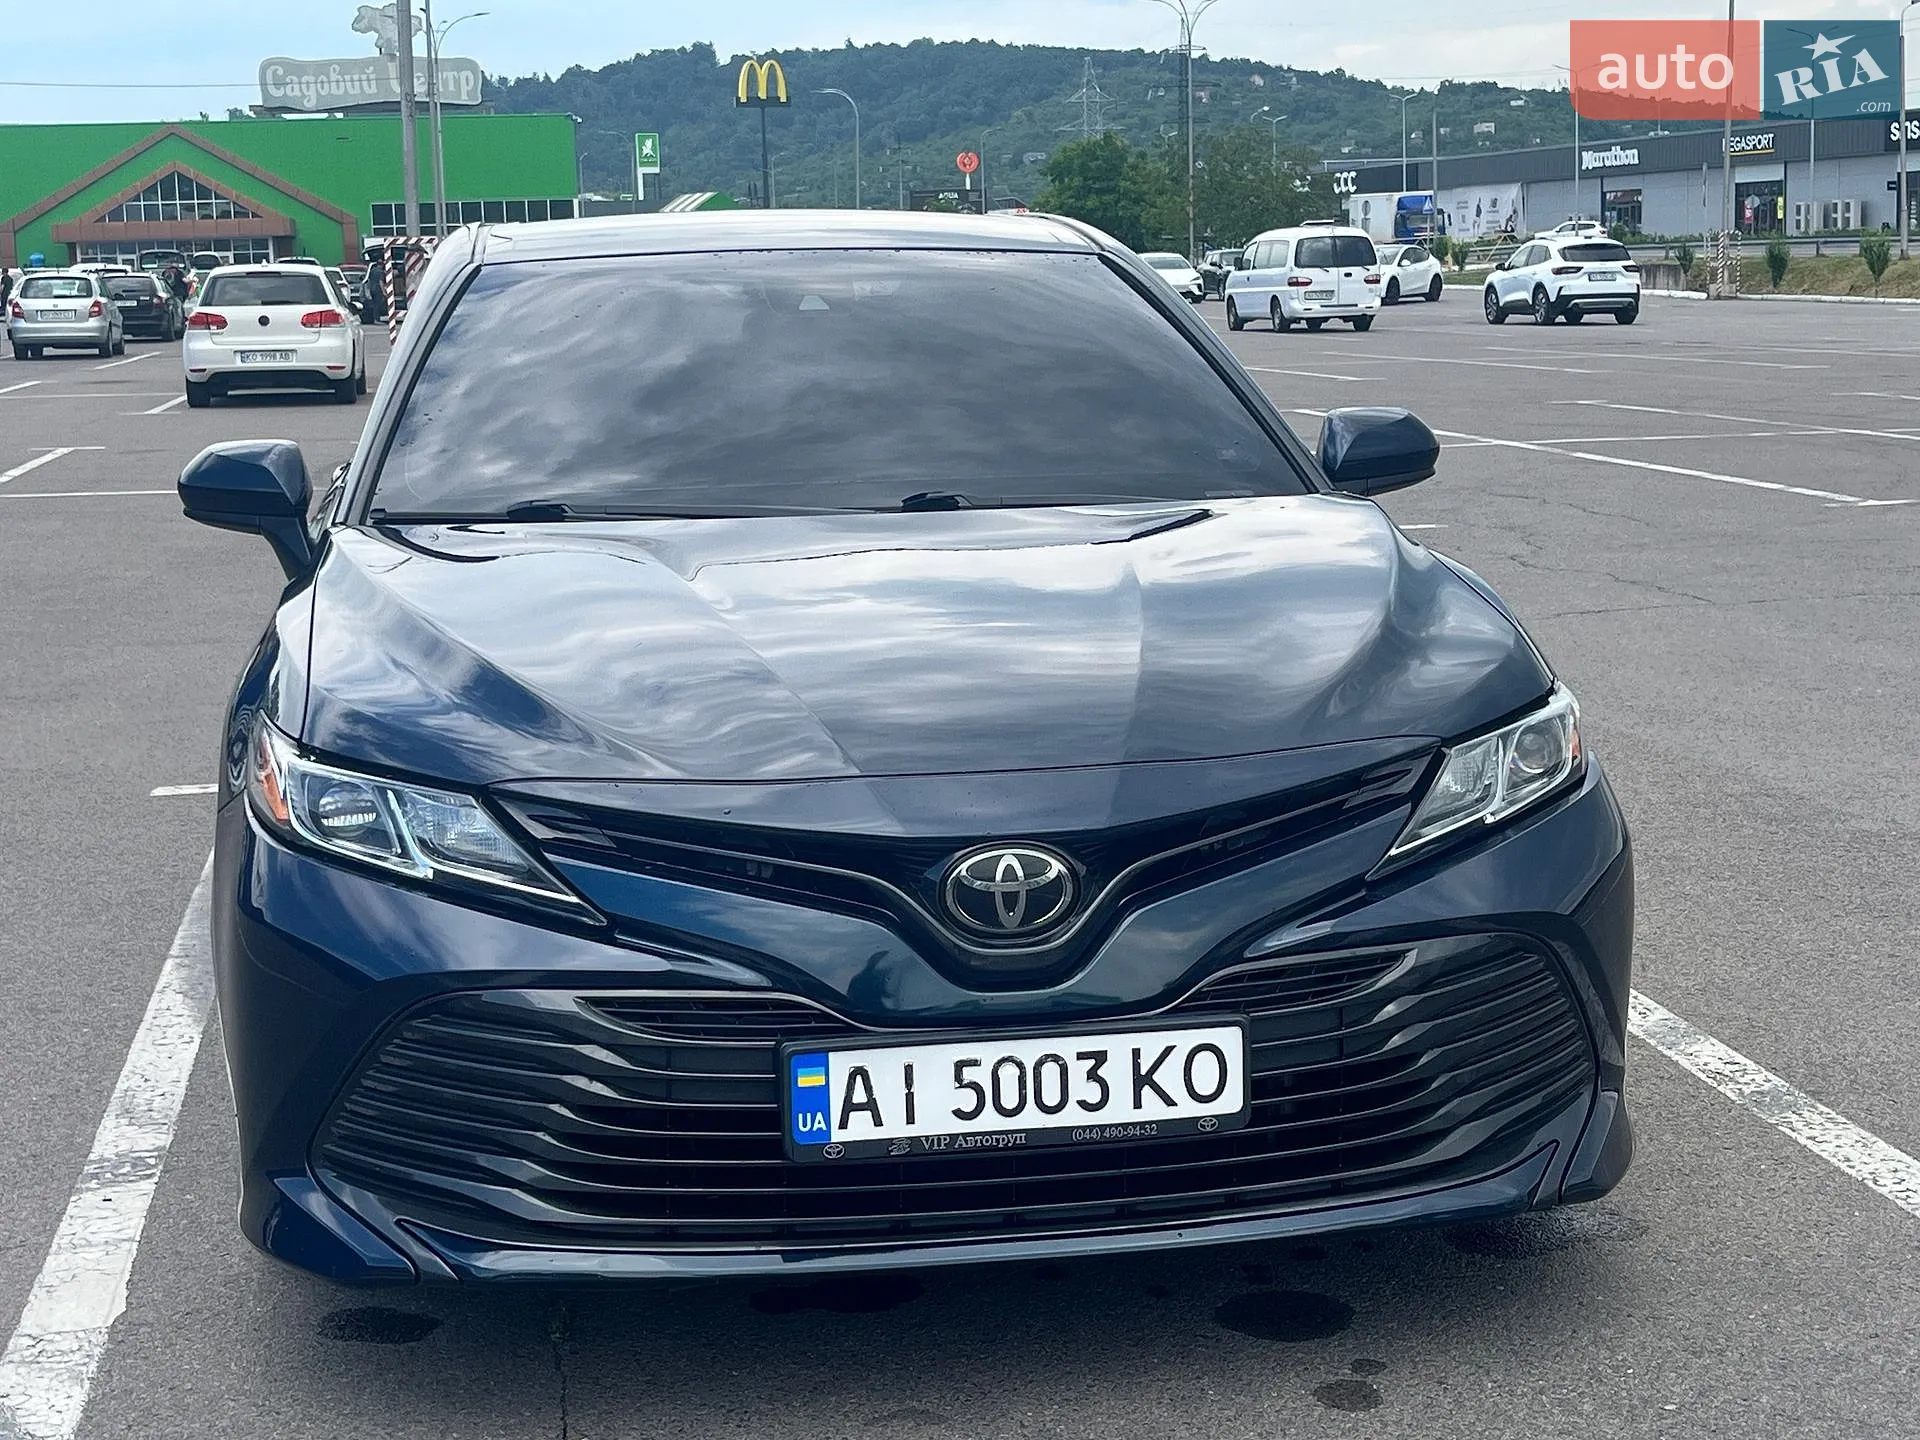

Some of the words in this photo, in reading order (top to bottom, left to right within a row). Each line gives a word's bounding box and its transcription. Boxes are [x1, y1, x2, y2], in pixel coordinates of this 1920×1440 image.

[266, 64, 377, 107] Садовий
[1581, 146, 1639, 170] Marathon
[1333, 171, 1357, 194] CCC
[838, 1061, 916, 1130] AI
[951, 1050, 1110, 1121] 5003
[1132, 1042, 1228, 1110] KO
[799, 1111, 827, 1132] UA
[1072, 1125, 1101, 1142] (044)
[1103, 1124, 1158, 1140] 490-94-32
[920, 1135, 950, 1150] VIP
[954, 1133, 1027, 1148] Автогруп
